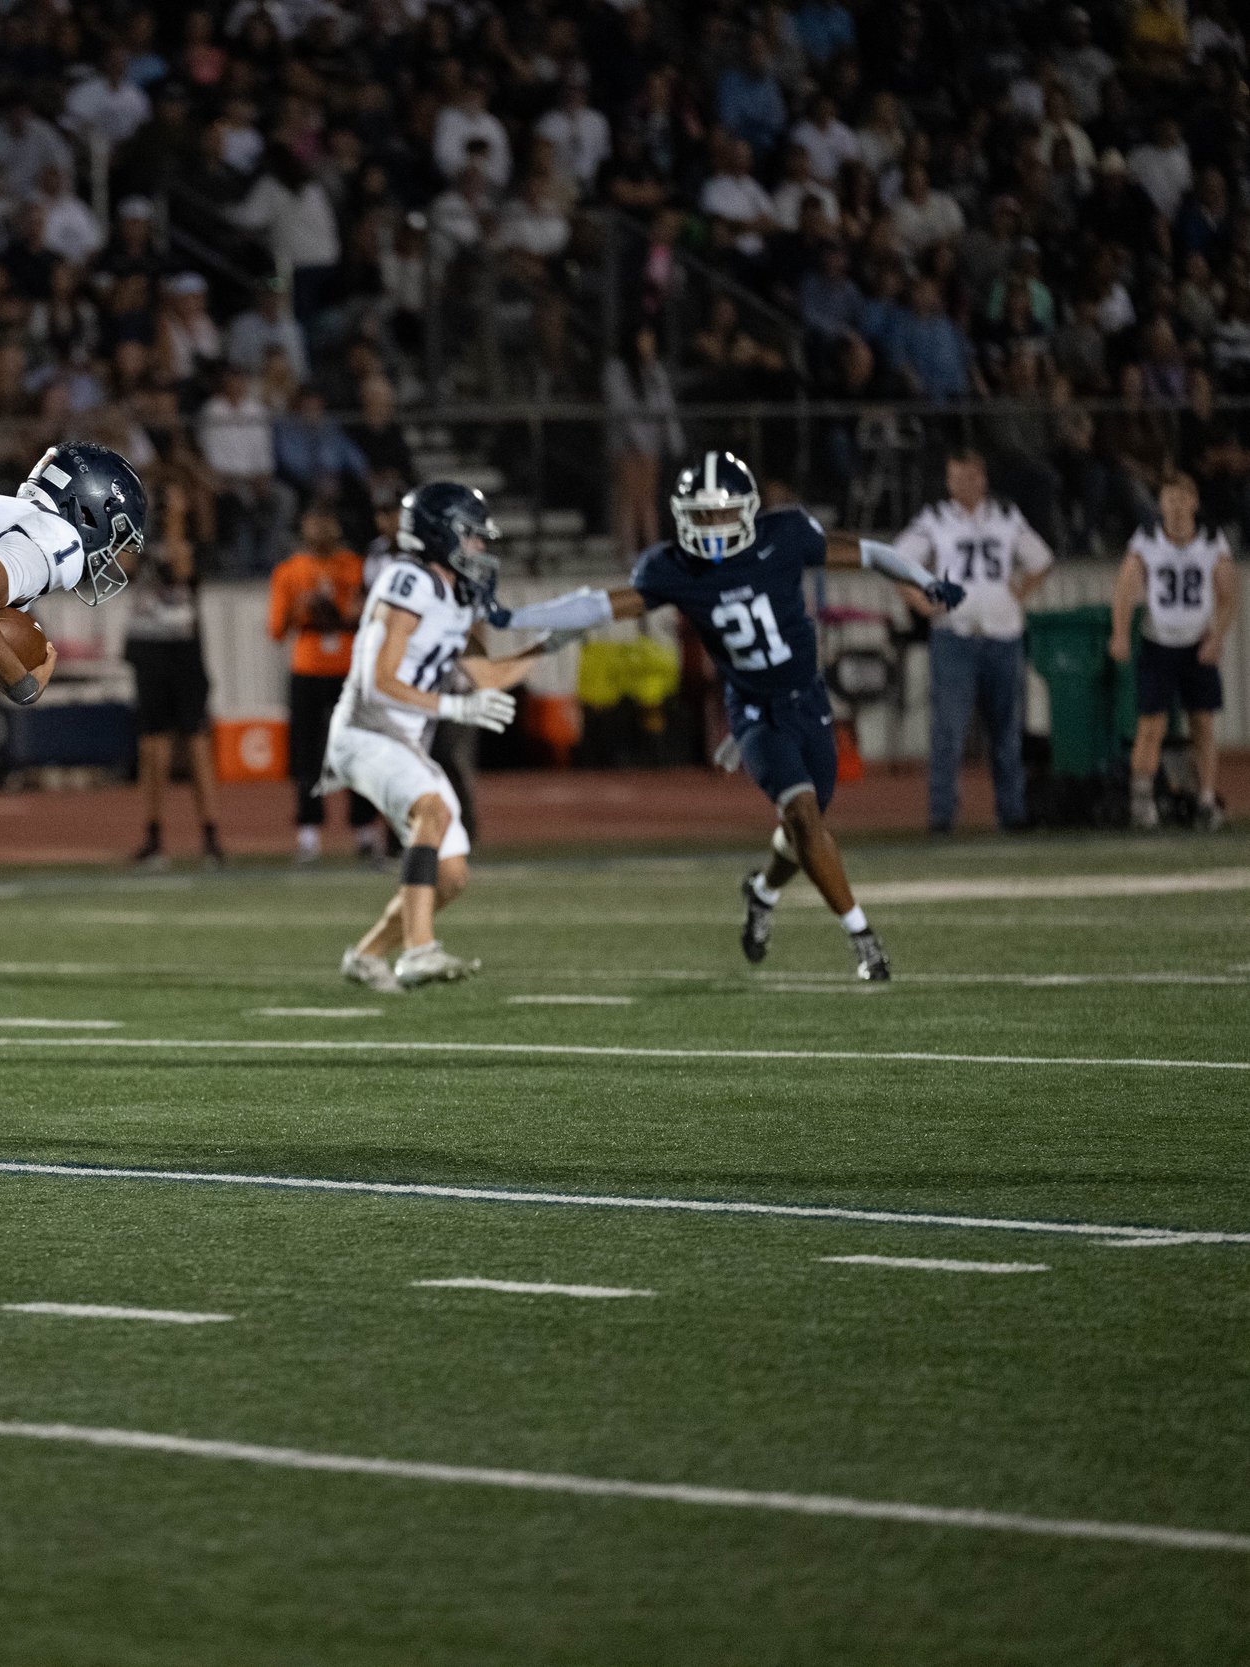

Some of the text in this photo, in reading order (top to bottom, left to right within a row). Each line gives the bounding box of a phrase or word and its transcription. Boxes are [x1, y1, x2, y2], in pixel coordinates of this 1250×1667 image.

[52, 539, 82, 567] 1
[957, 539, 1001, 580] 75
[389, 570, 417, 598] 16
[711, 591, 793, 672] 21
